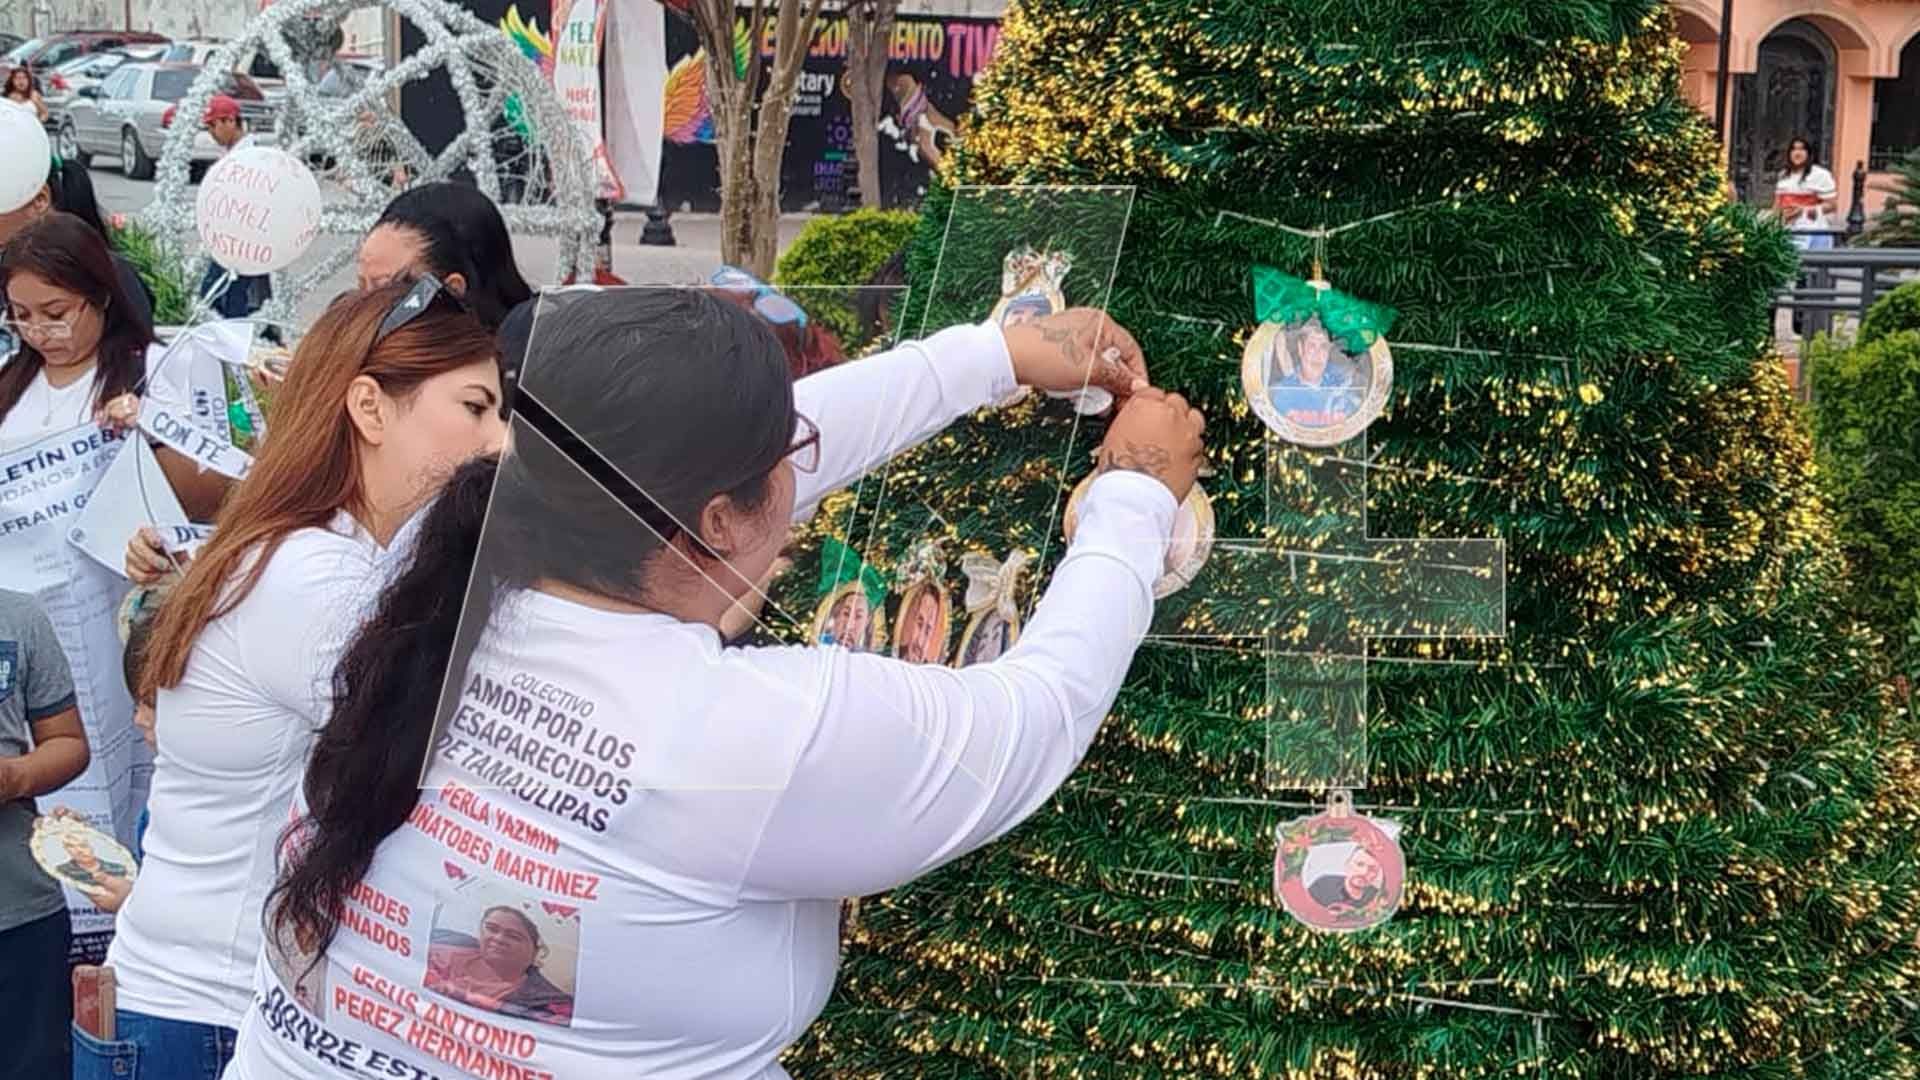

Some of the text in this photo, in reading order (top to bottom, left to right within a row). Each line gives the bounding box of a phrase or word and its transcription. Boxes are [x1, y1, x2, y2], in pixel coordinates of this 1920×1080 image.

[799, 72, 835, 97] tary
[152, 411, 194, 447] CON
[465, 672, 637, 770] AMOR POR LOS
[511, 672, 595, 719] COLECTIVO
[453, 704, 632, 806] ESAPARECIDOS
[439, 781, 561, 855] PERLA YAZMIN
[461, 747, 610, 833] TAMAULIPAS
[403, 803, 600, 900] UÑATOBES MARTINEZ
[334, 985, 406, 1041] PEREZ
[424, 1002, 537, 1059] ANTONIO
